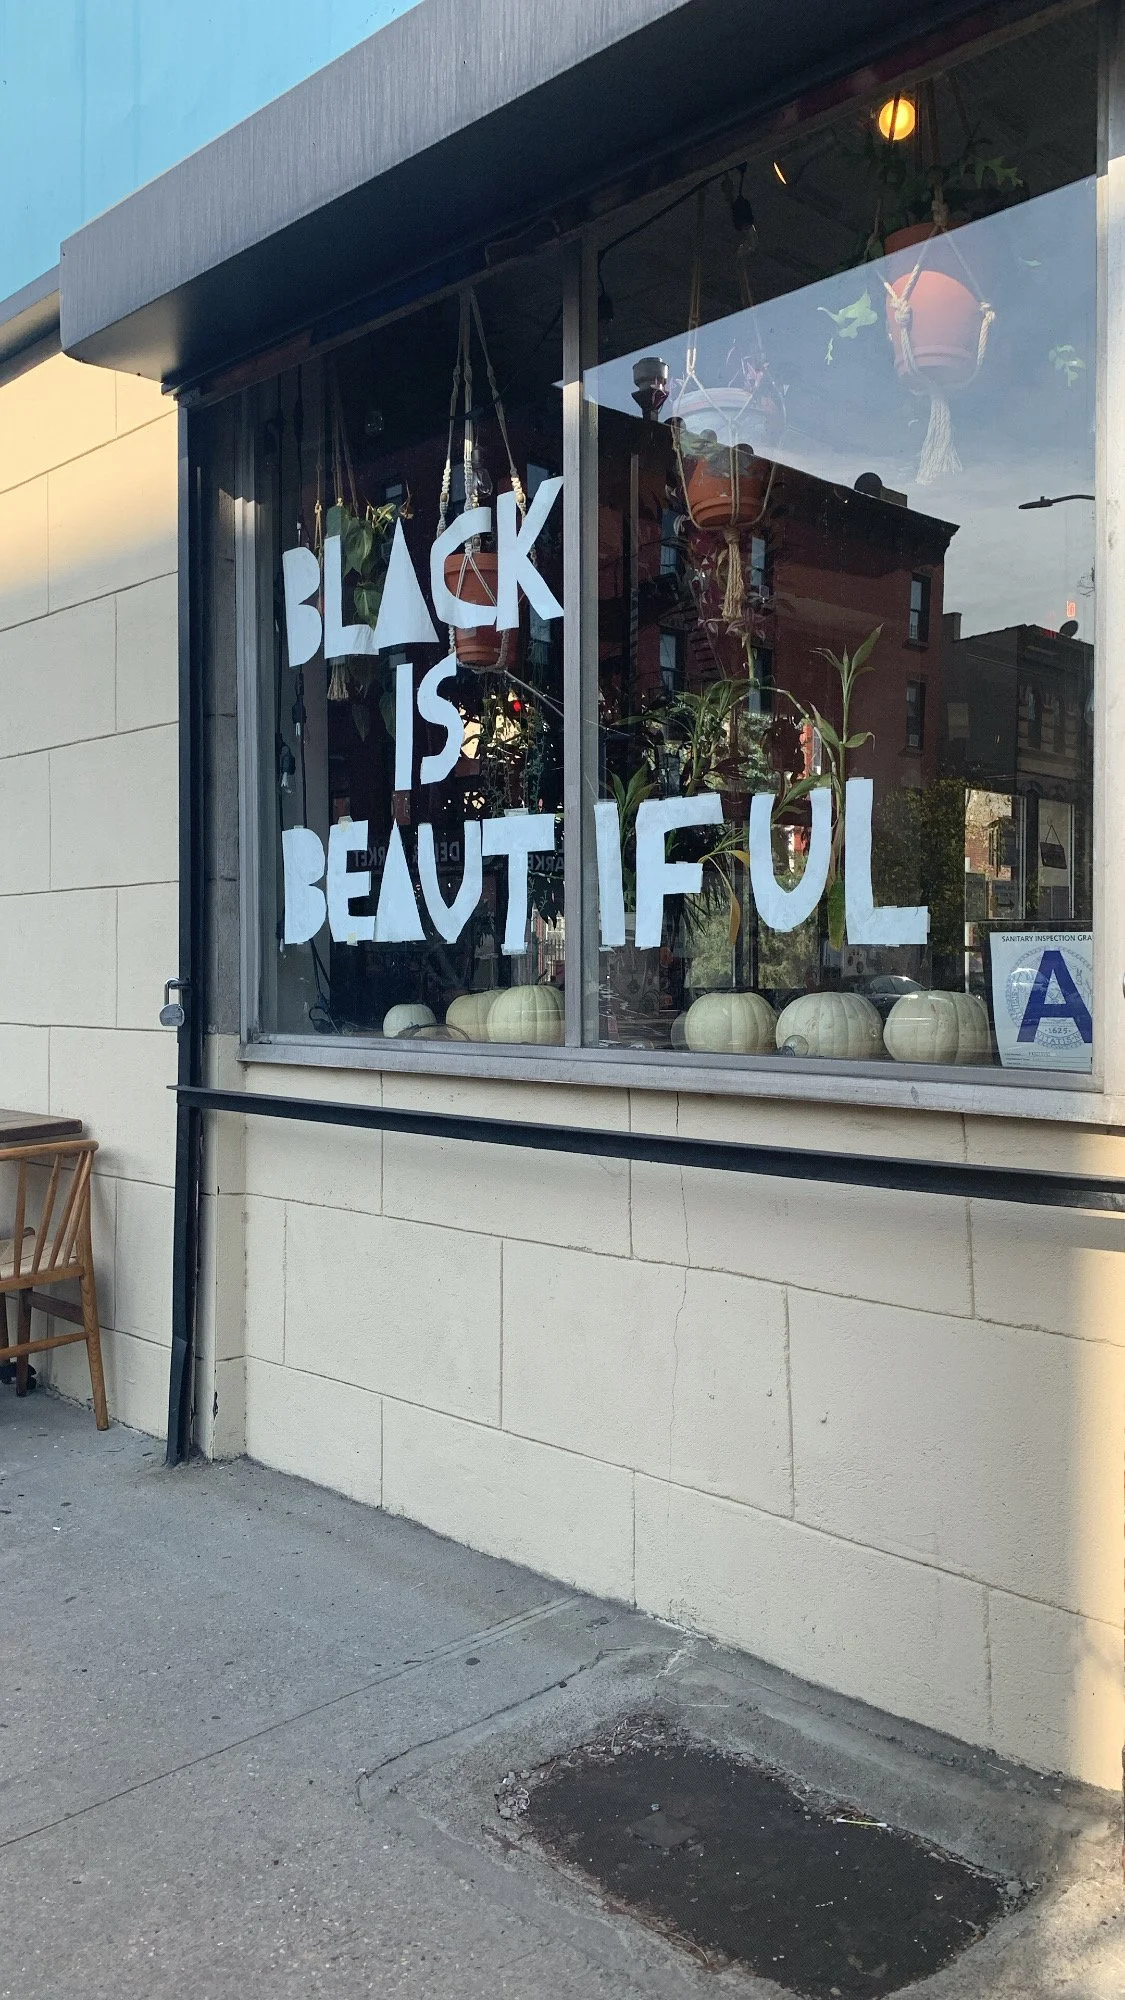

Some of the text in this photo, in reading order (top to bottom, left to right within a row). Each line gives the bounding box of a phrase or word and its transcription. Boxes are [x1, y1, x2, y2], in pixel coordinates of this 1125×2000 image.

[282, 476, 564, 668] BLACK
[394, 651, 464, 791] IS
[281, 777, 930, 954] BEAUTIFUL
[1017, 951, 1092, 1043] A
[1035, 934, 1076, 942] INSPECTION
